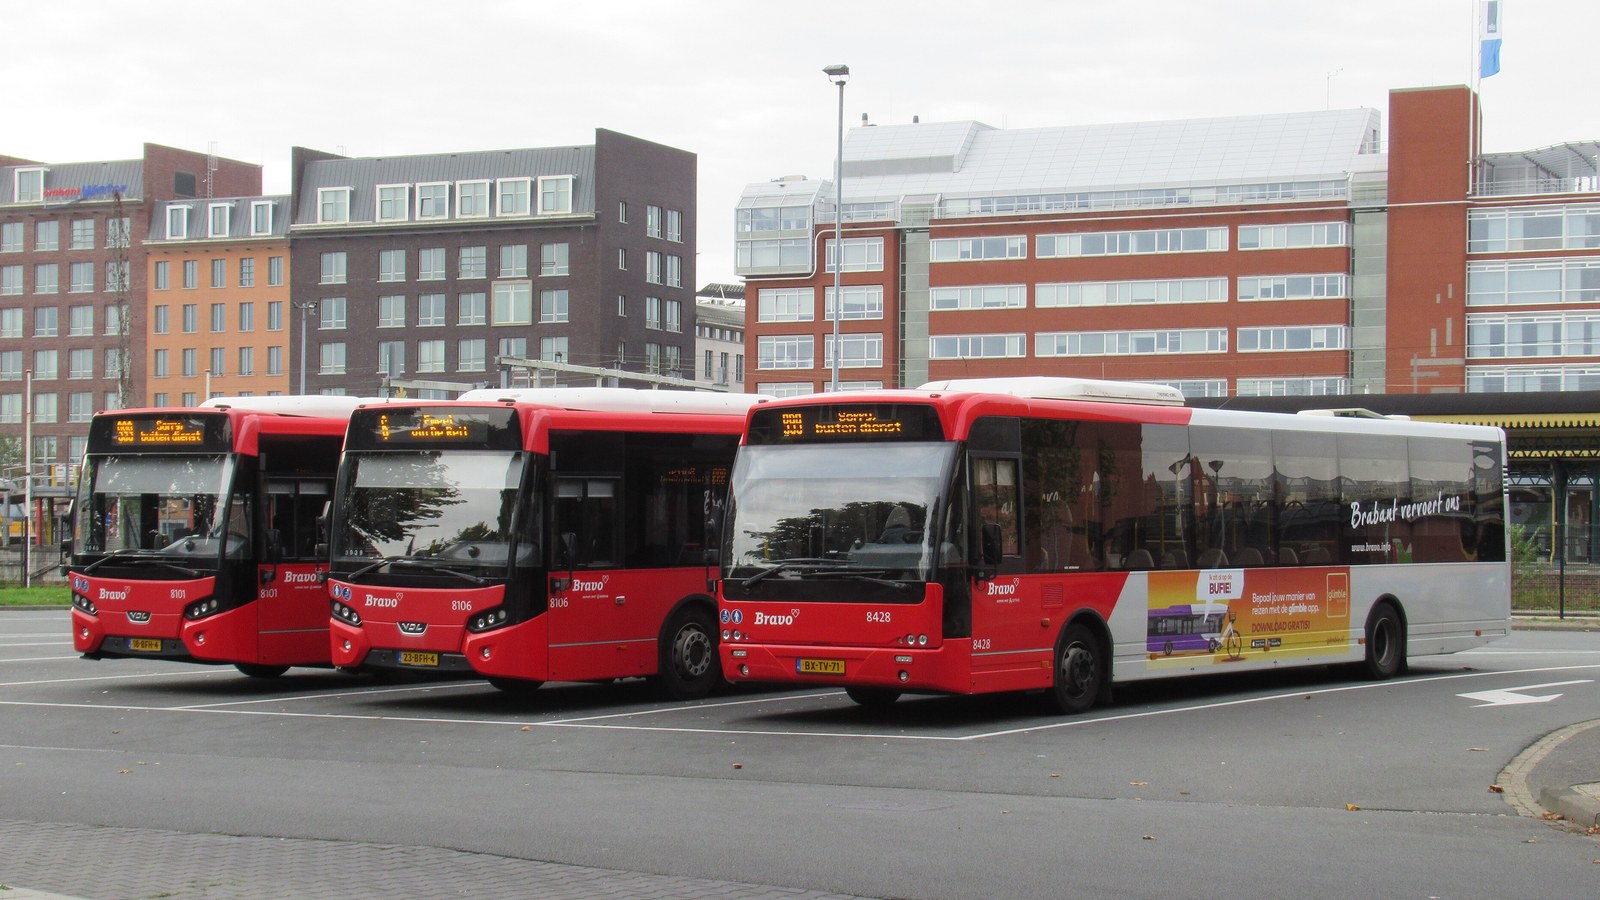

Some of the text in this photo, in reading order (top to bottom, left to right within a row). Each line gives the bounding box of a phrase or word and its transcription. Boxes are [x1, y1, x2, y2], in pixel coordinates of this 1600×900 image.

[815, 422, 902, 434] buiten dienst
[1350, 491, 1460, 529] Brabant vervoert ons
[1351, 542, 1391, 553] www.bravo.info
[283, 571, 317, 583] Bravo
[571, 579, 604, 592] Bravo
[987, 582, 1015, 595] Bravo
[99, 588, 127, 600] Bravo
[170, 589, 186, 599] 8101
[260, 588, 278, 599] 8101
[1252, 591, 1316, 604] Bepaal jouw manier van
[365, 594, 398, 608] Bravo
[451, 600, 472, 611] 8106
[550, 597, 569, 608] 8106
[1251, 605, 1269, 615] reizen
[1269, 605, 1280, 614] met
[1281, 604, 1288, 613] de
[1288, 603, 1307, 615] glimble
[129, 611, 148, 620] VDL
[754, 611, 793, 625] Bravo
[866, 612, 891, 622] 8428
[401, 622, 423, 631] VDL
[1251, 620, 1310, 632] DOWNLOAD GRATIS!
[973, 638, 991, 650] 8428
[403, 653, 435, 662] 23-BFH-4
[804, 661, 840, 671] BX-TV-71
